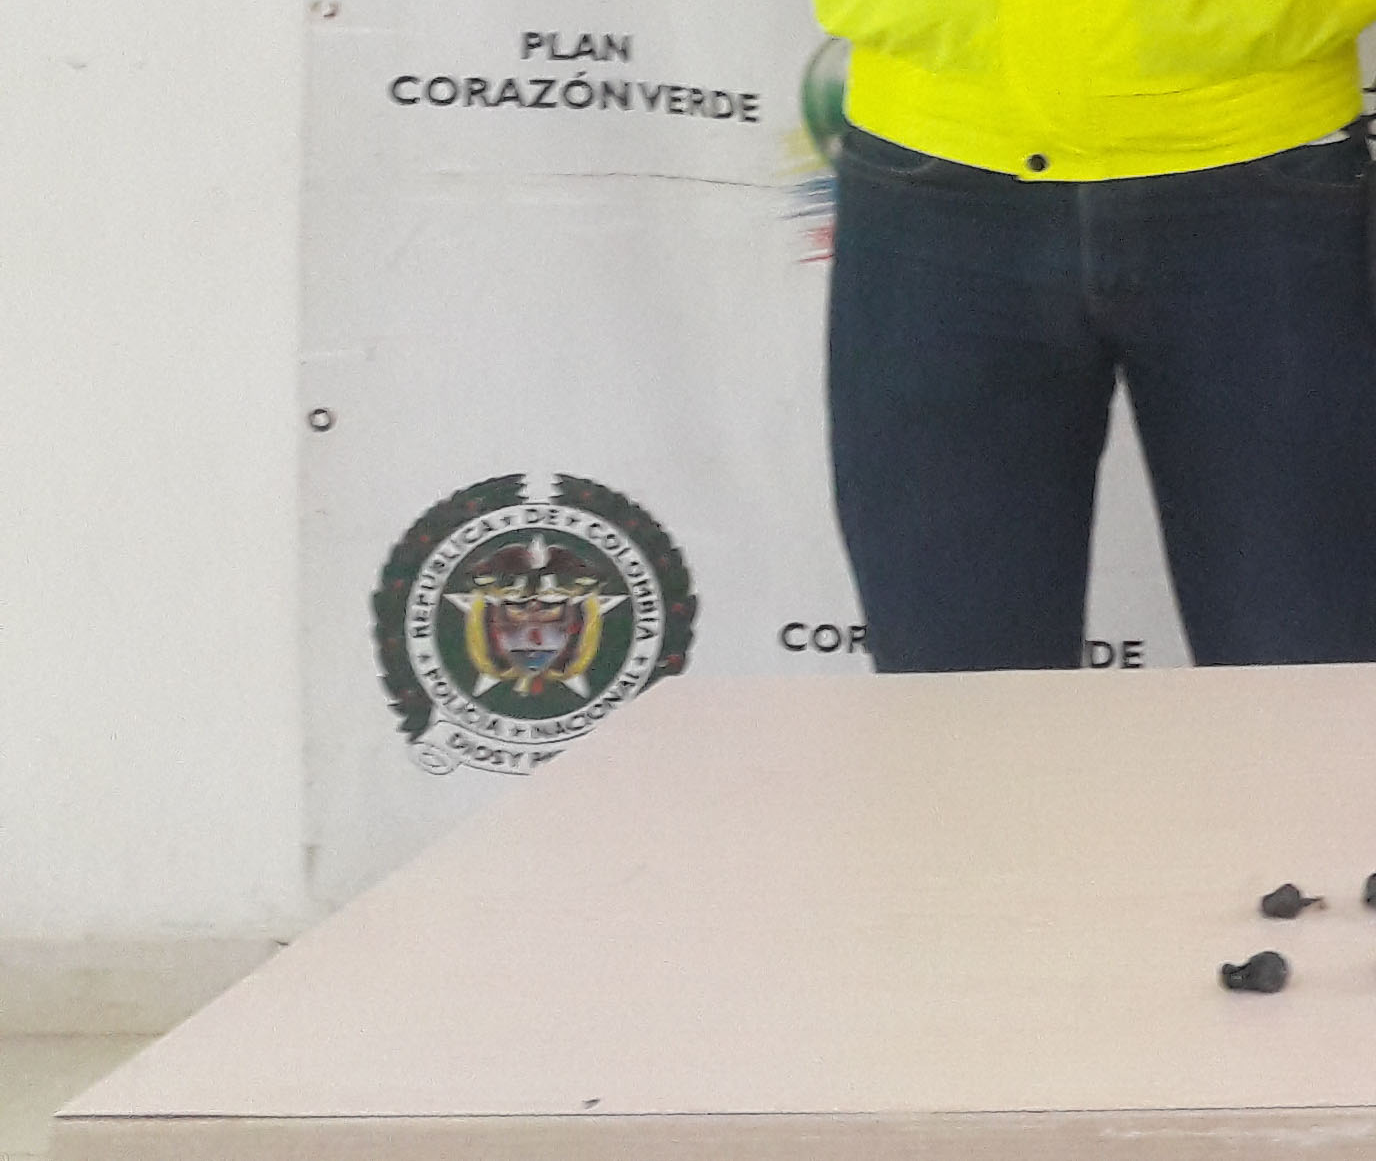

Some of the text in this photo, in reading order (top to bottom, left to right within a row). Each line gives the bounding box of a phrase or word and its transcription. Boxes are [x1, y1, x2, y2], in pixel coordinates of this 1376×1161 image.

[520, 31, 634, 62] PLAN
[389, 70, 760, 123] CORAZÓN VERDE
[525, 508, 561, 527] DE
